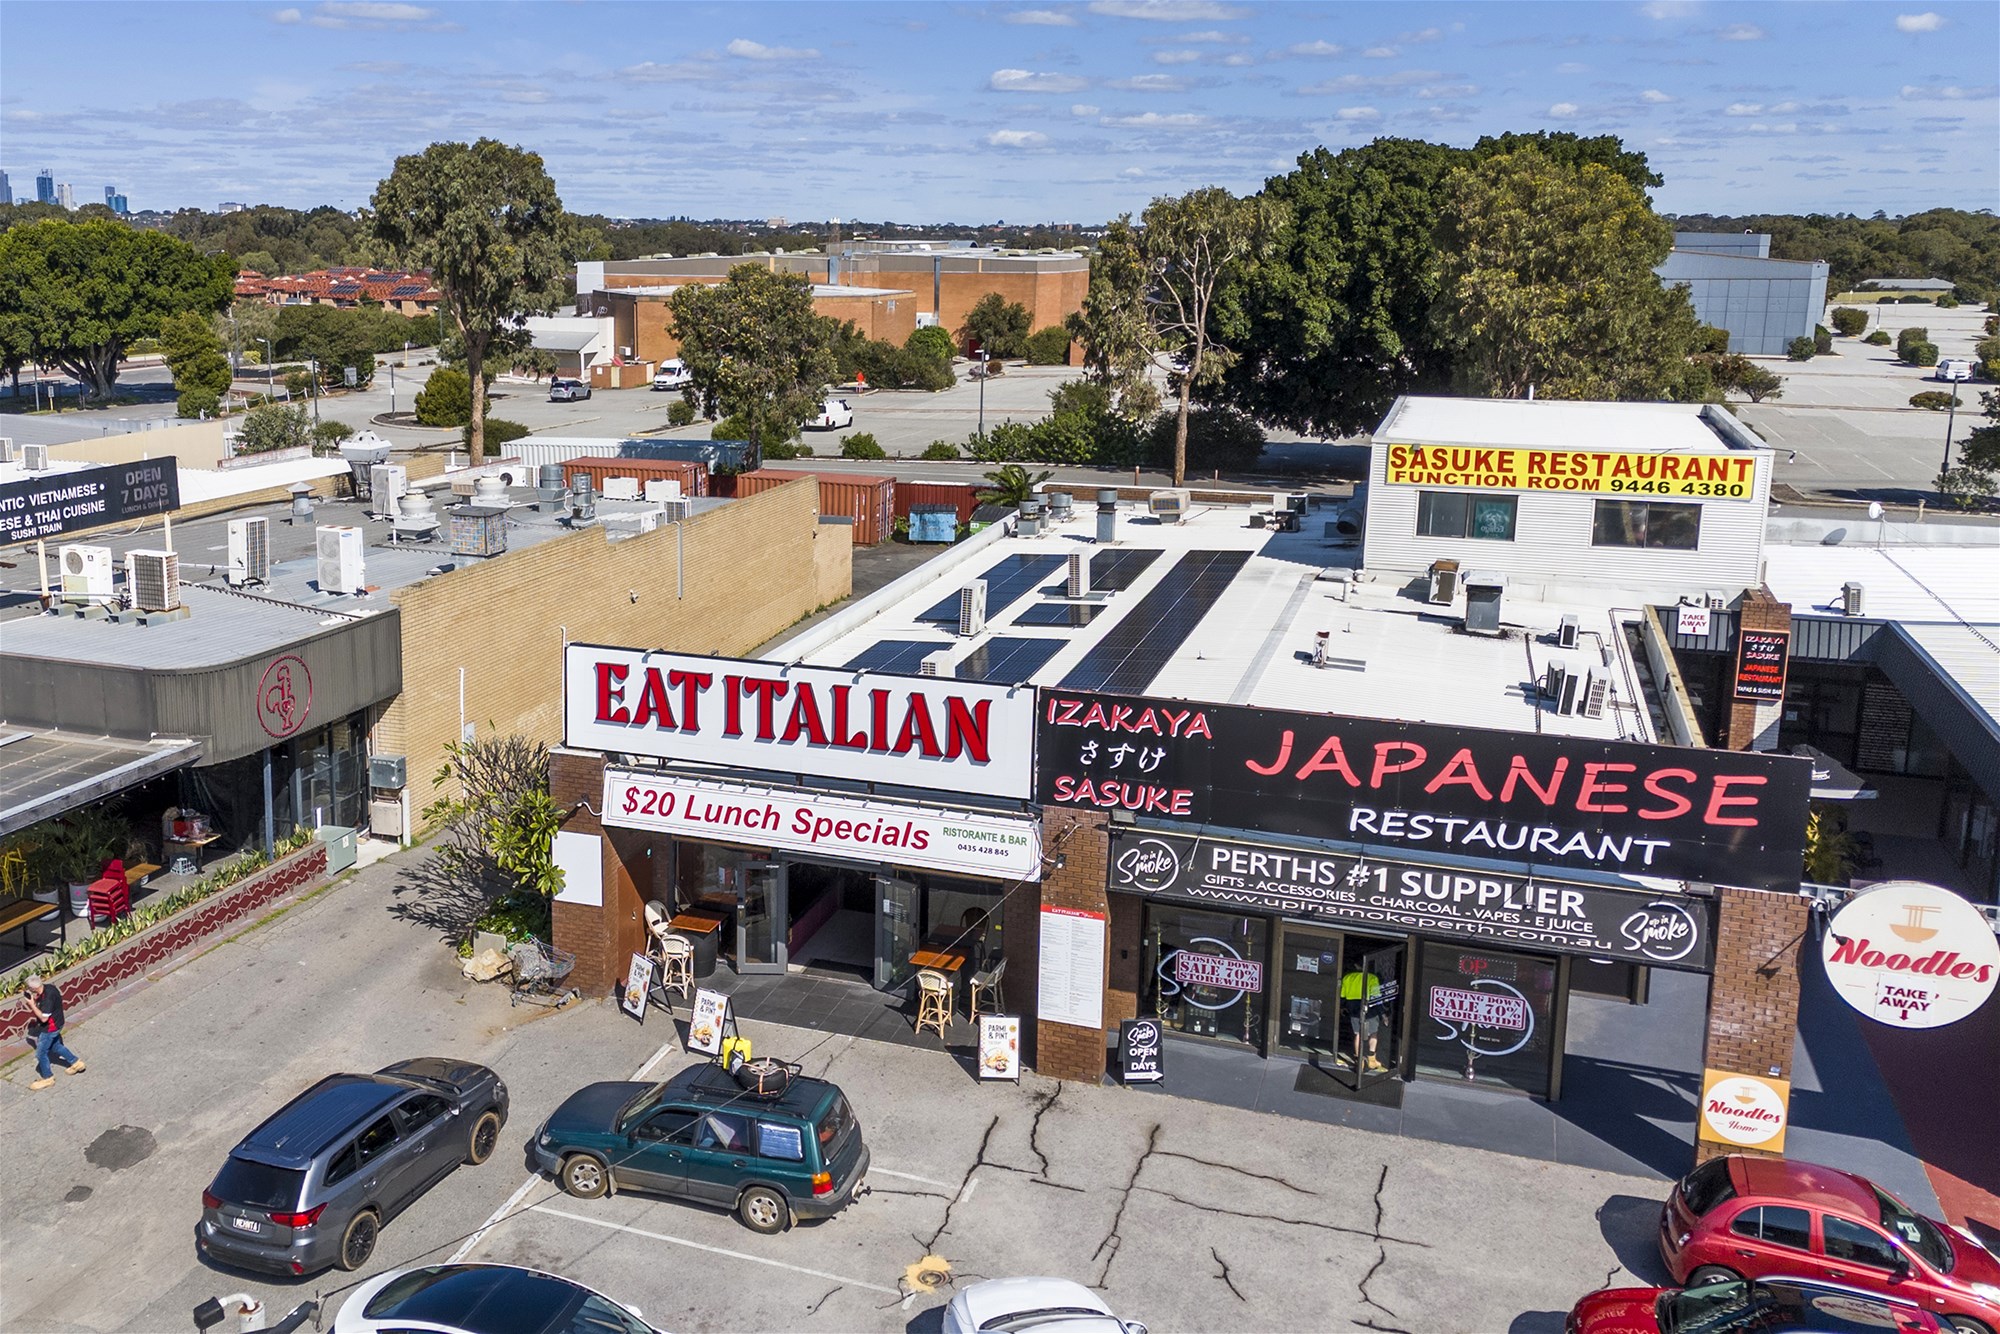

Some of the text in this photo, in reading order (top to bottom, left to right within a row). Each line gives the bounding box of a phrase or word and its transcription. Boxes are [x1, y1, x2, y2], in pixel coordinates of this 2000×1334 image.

[1390, 447, 1754, 482] SASUKE RESTAURANT
[125, 467, 161, 486] OPEN
[1395, 471, 1744, 497] FUNCTION ROOM 9446 4380
[29, 483, 98, 506] VIETNAMESE
[121, 483, 168, 504] 7 DAYS
[24, 514, 33, 526] &
[35, 507, 61, 525] THAI
[63, 500, 106, 519] CUISINE
[11, 522, 63, 541] SUSHI TRAIN
[1746, 652, 1780, 660] SASUKE
[1738, 673, 1782, 683] RESTAURANT
[1744, 664, 1779, 673] JAPANESE
[594, 662, 992, 765] EAT ITALIAN
[1046, 698, 1213, 740] IZAKAYA
[1080, 740, 1166, 773] さすけ
[1245, 730, 1768, 827] JAPANESE
[1053, 775, 1194, 815] SASUKE
[622, 786, 930, 851] $20 Lunch Specials
[943, 827, 1027, 846] RISTORANTE & BAR
[1348, 807, 1671, 865] RESTAURANT
[958, 843, 1009, 857] 0435 428 845
[1212, 847, 1587, 918] PERTHS #1 SUPPLIER
[1204, 874, 1245, 888] GIFTS
[1256, 881, 1356, 903] ACCESSORIES
[1370, 896, 1461, 917] CHARCOAL
[1473, 908, 1520, 924] VAPES
[1547, 918, 1593, 933] JUICE
[1187, 887, 1612, 950] www.upinsmokeperth.com.au
[1181, 954, 1258, 971] CLOSING DOWN
[1829, 936, 1994, 983] Noodles
[1180, 961, 1258, 982] SALE 70%
[1180, 972, 1258, 990] STOREWIDE
[1435, 990, 1521, 1008] CLOSING DOWN
[1885, 985, 1928, 1000] TAKE
[1435, 997, 1521, 1019] SALE 70%
[1879, 997, 1931, 1011] AWAY
[1434, 1008, 1521, 1027] STOREWIDE
[1129, 1048, 1158, 1056] OPEN
[1140, 1055, 1147, 1063] 7
[1131, 1062, 1157, 1070] DAYS
[1707, 1100, 1781, 1124] Noodles
[1728, 1120, 1759, 1133] Home
